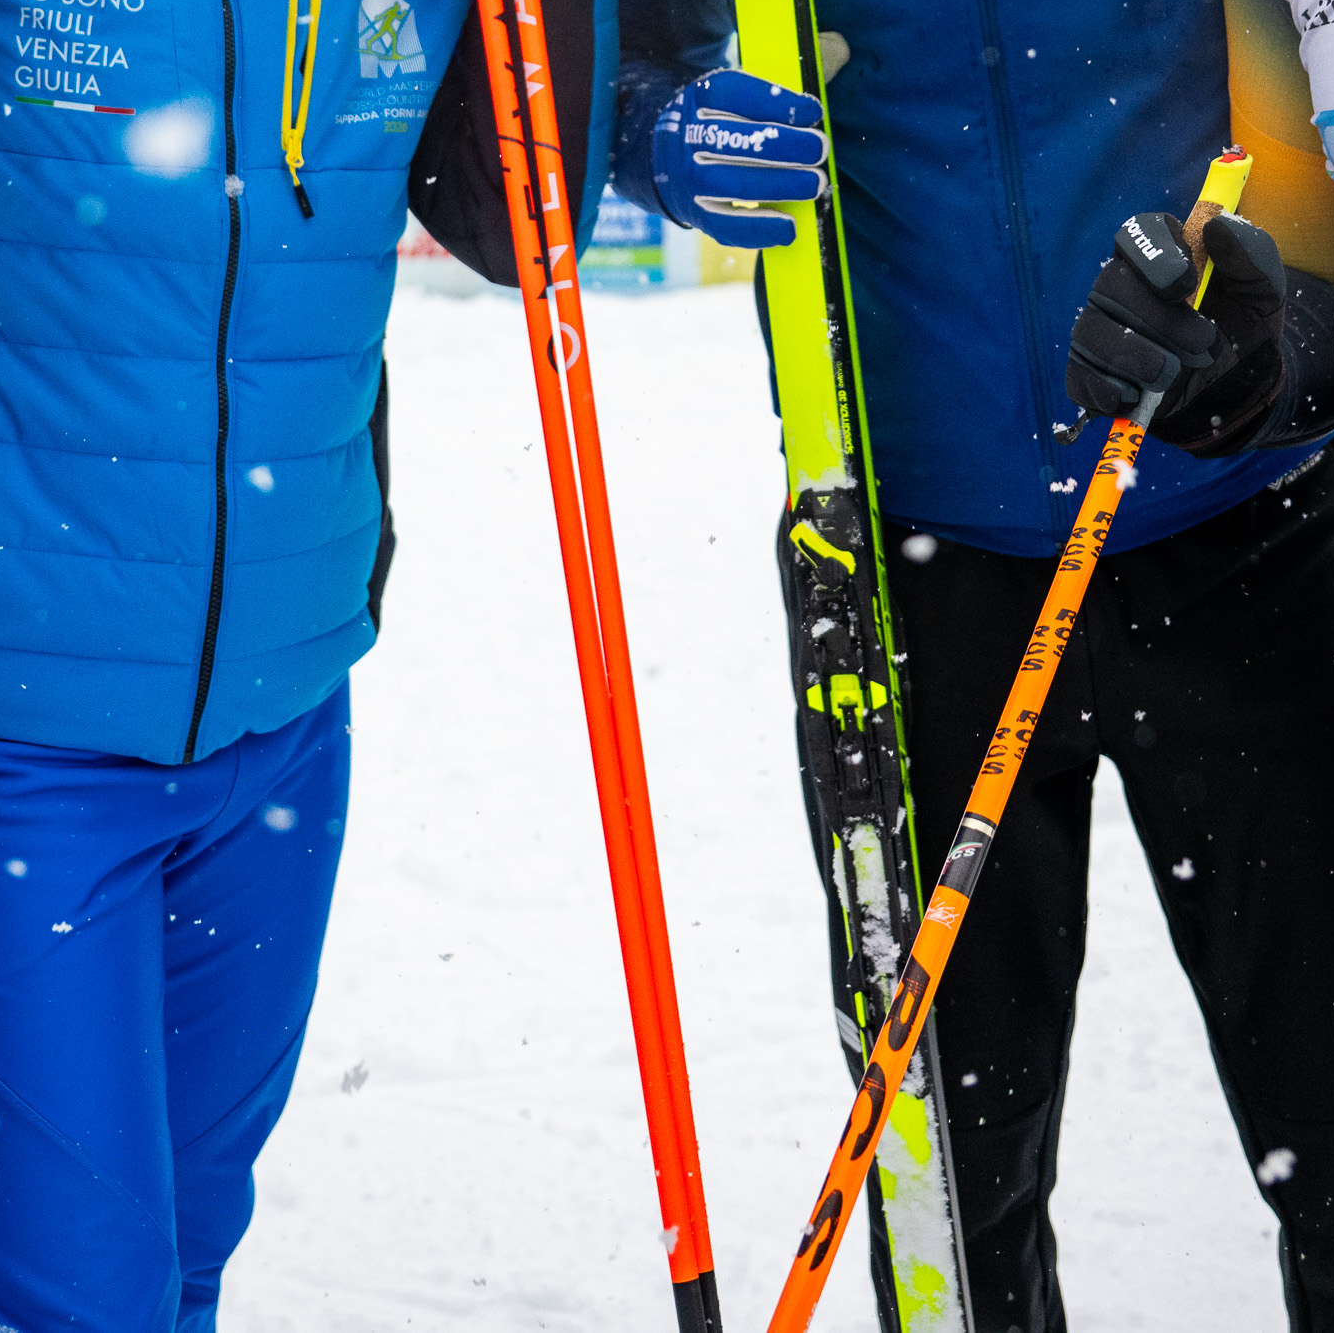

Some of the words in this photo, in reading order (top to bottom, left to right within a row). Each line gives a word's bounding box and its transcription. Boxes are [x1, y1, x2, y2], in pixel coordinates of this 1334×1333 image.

[19, 6, 94, 36] FRIULI
[15, 34, 129, 70] VENEZIA
[14, 65, 102, 97] GIULIA
[383, 108, 416, 118] FORNI
